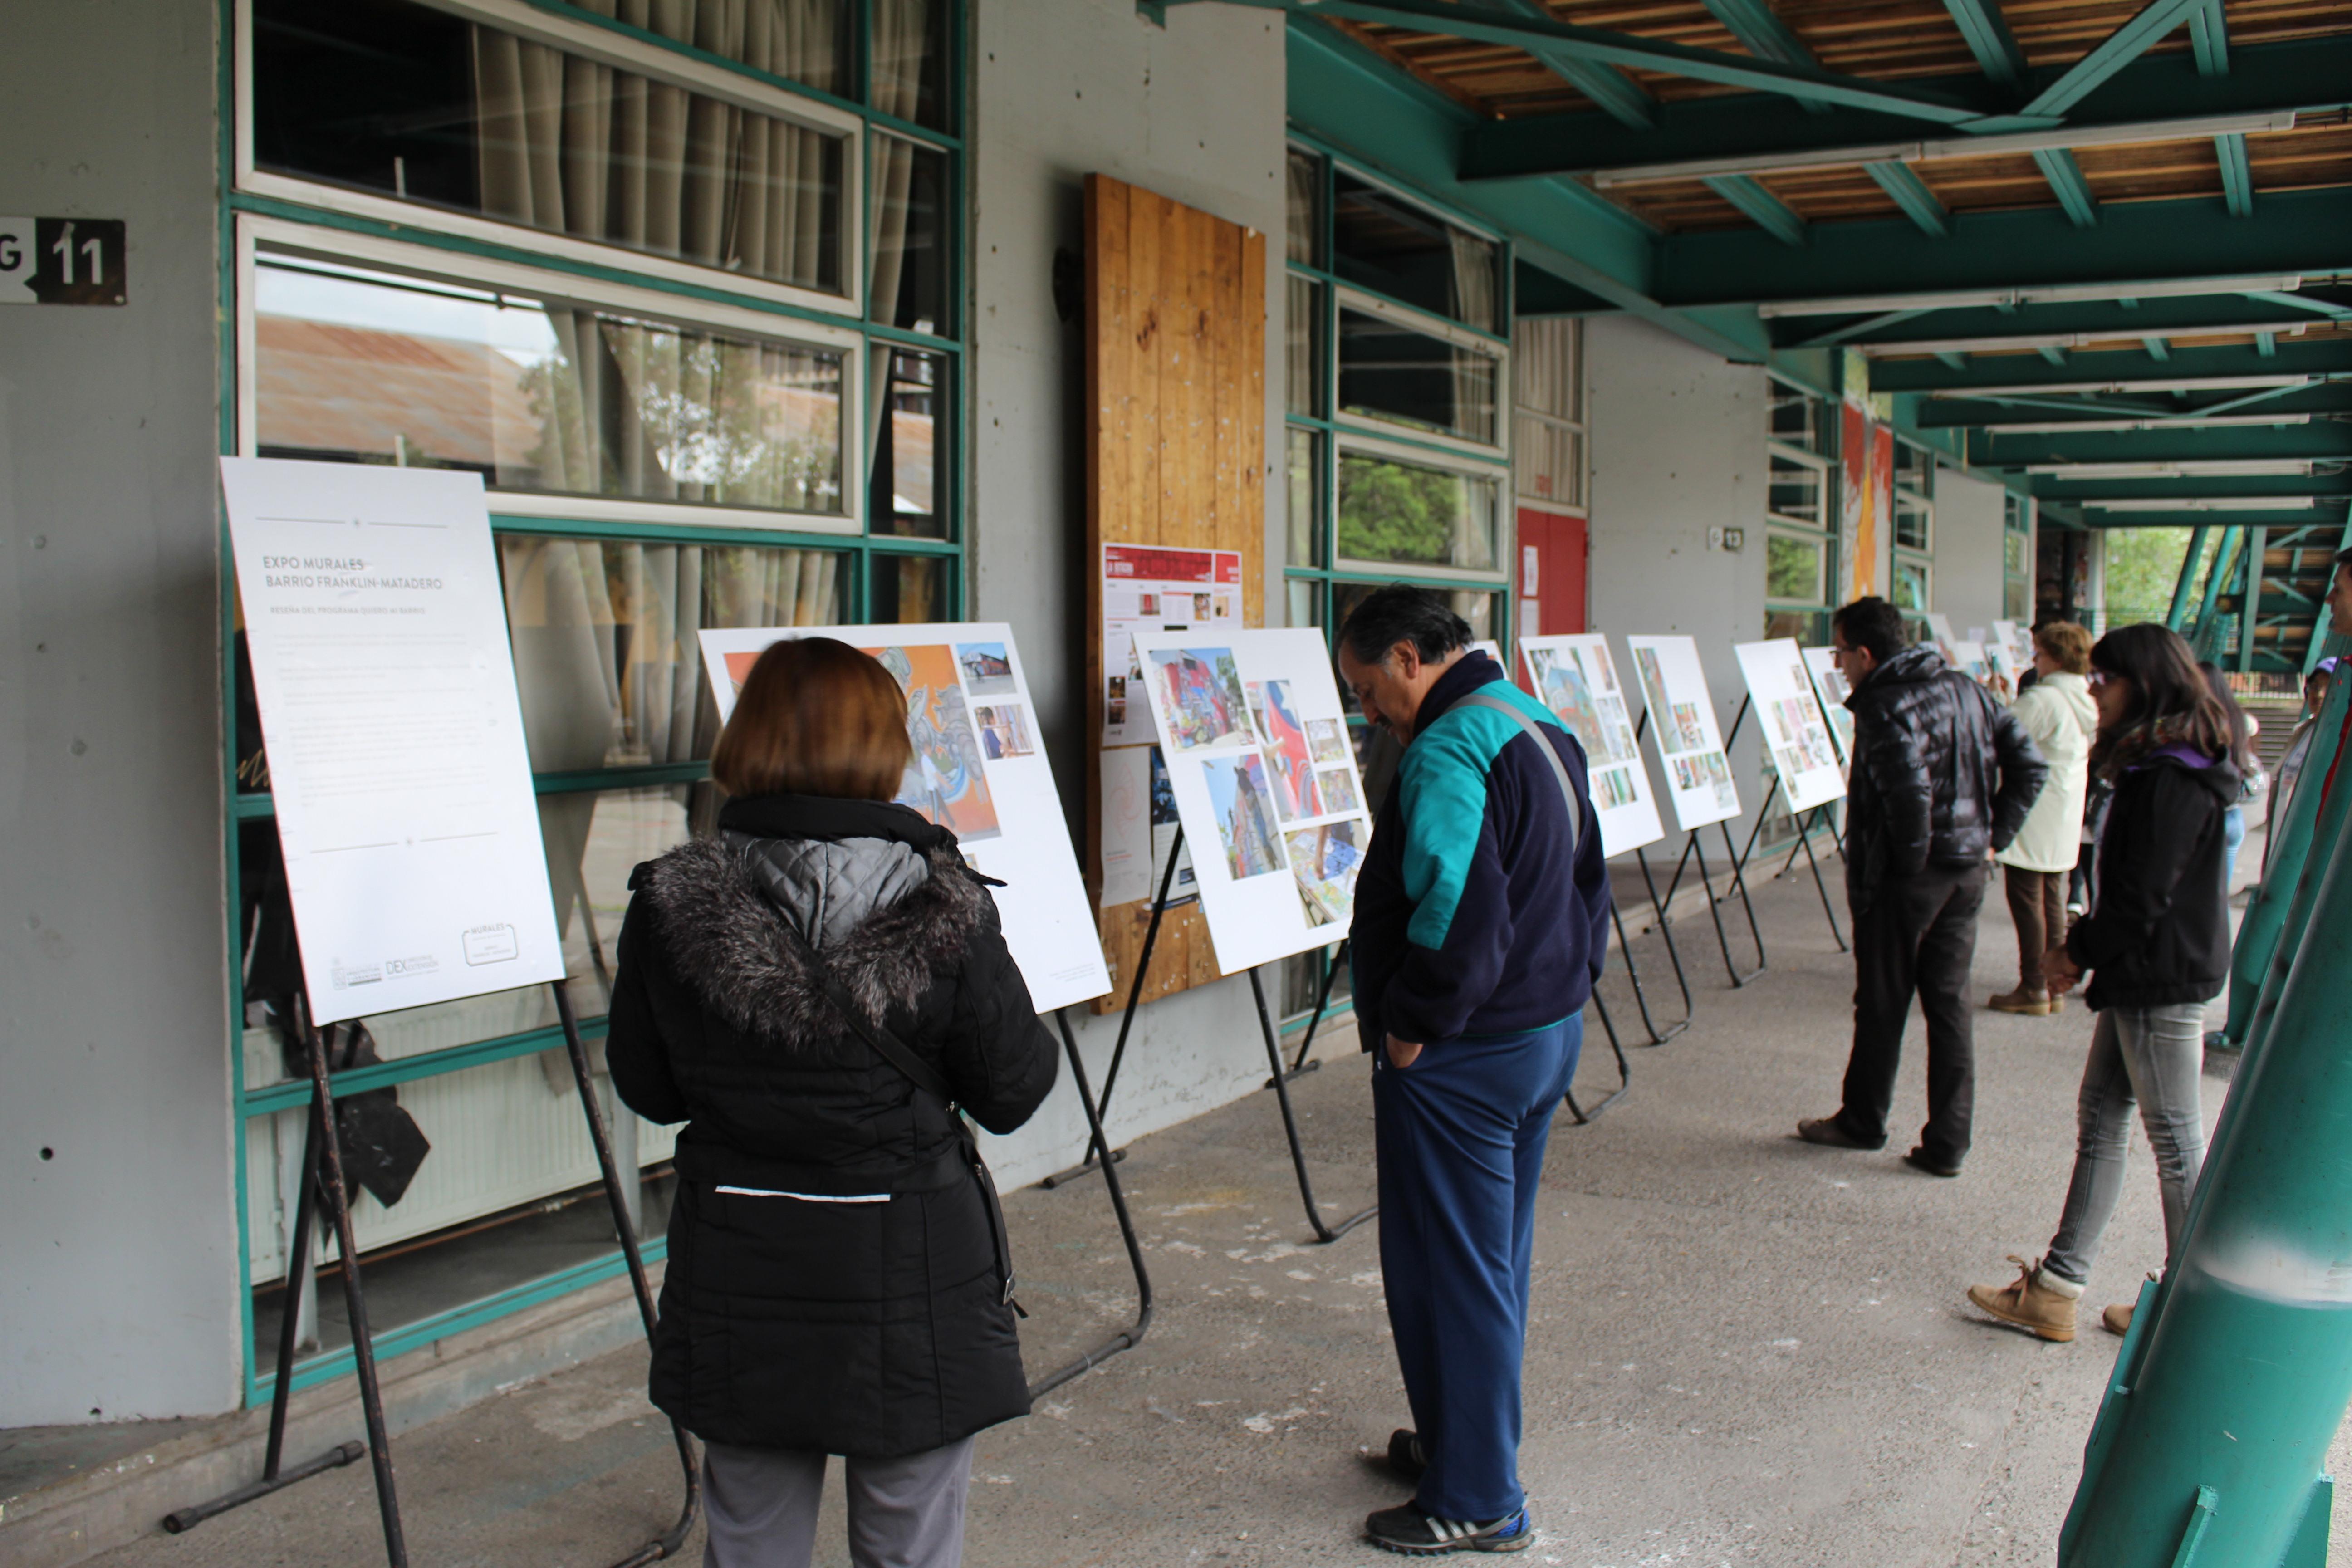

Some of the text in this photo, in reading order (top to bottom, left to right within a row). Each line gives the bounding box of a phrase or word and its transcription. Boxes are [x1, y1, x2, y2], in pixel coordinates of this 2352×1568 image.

[0, 228, 103, 284] G 11
[263, 556, 364, 571] EXPO MURALES
[266, 575, 442, 589] BARRIO FRANKLIN-MATADERO
[317, 606, 359, 614] PROGRAMA
[360, 607, 387, 616] QUIERO
[470, 922, 505, 934] MURALES
[385, 960, 407, 975] DEX
